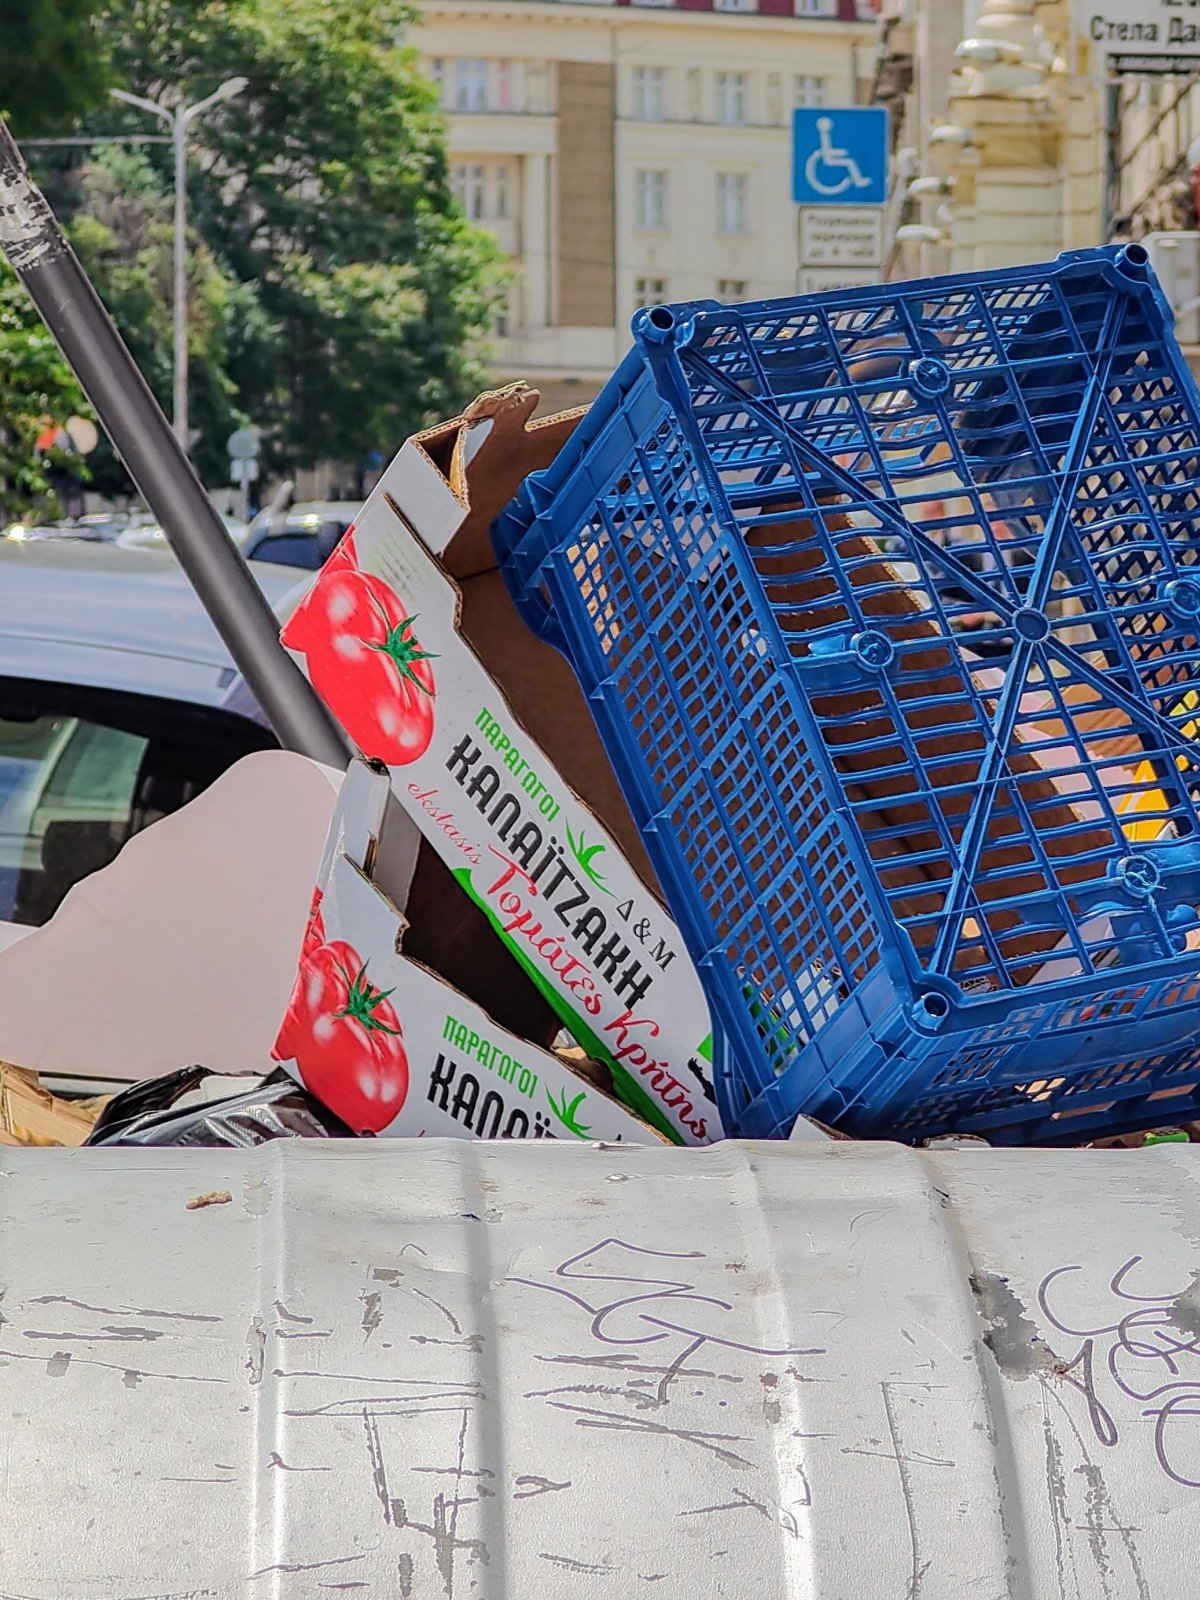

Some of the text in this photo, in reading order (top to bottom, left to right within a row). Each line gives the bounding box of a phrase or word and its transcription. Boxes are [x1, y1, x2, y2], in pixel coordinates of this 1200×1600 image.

[1090, 15, 1159, 42] Стела
[407, 782, 481, 865] ekstasis
[633, 918, 651, 945] &
